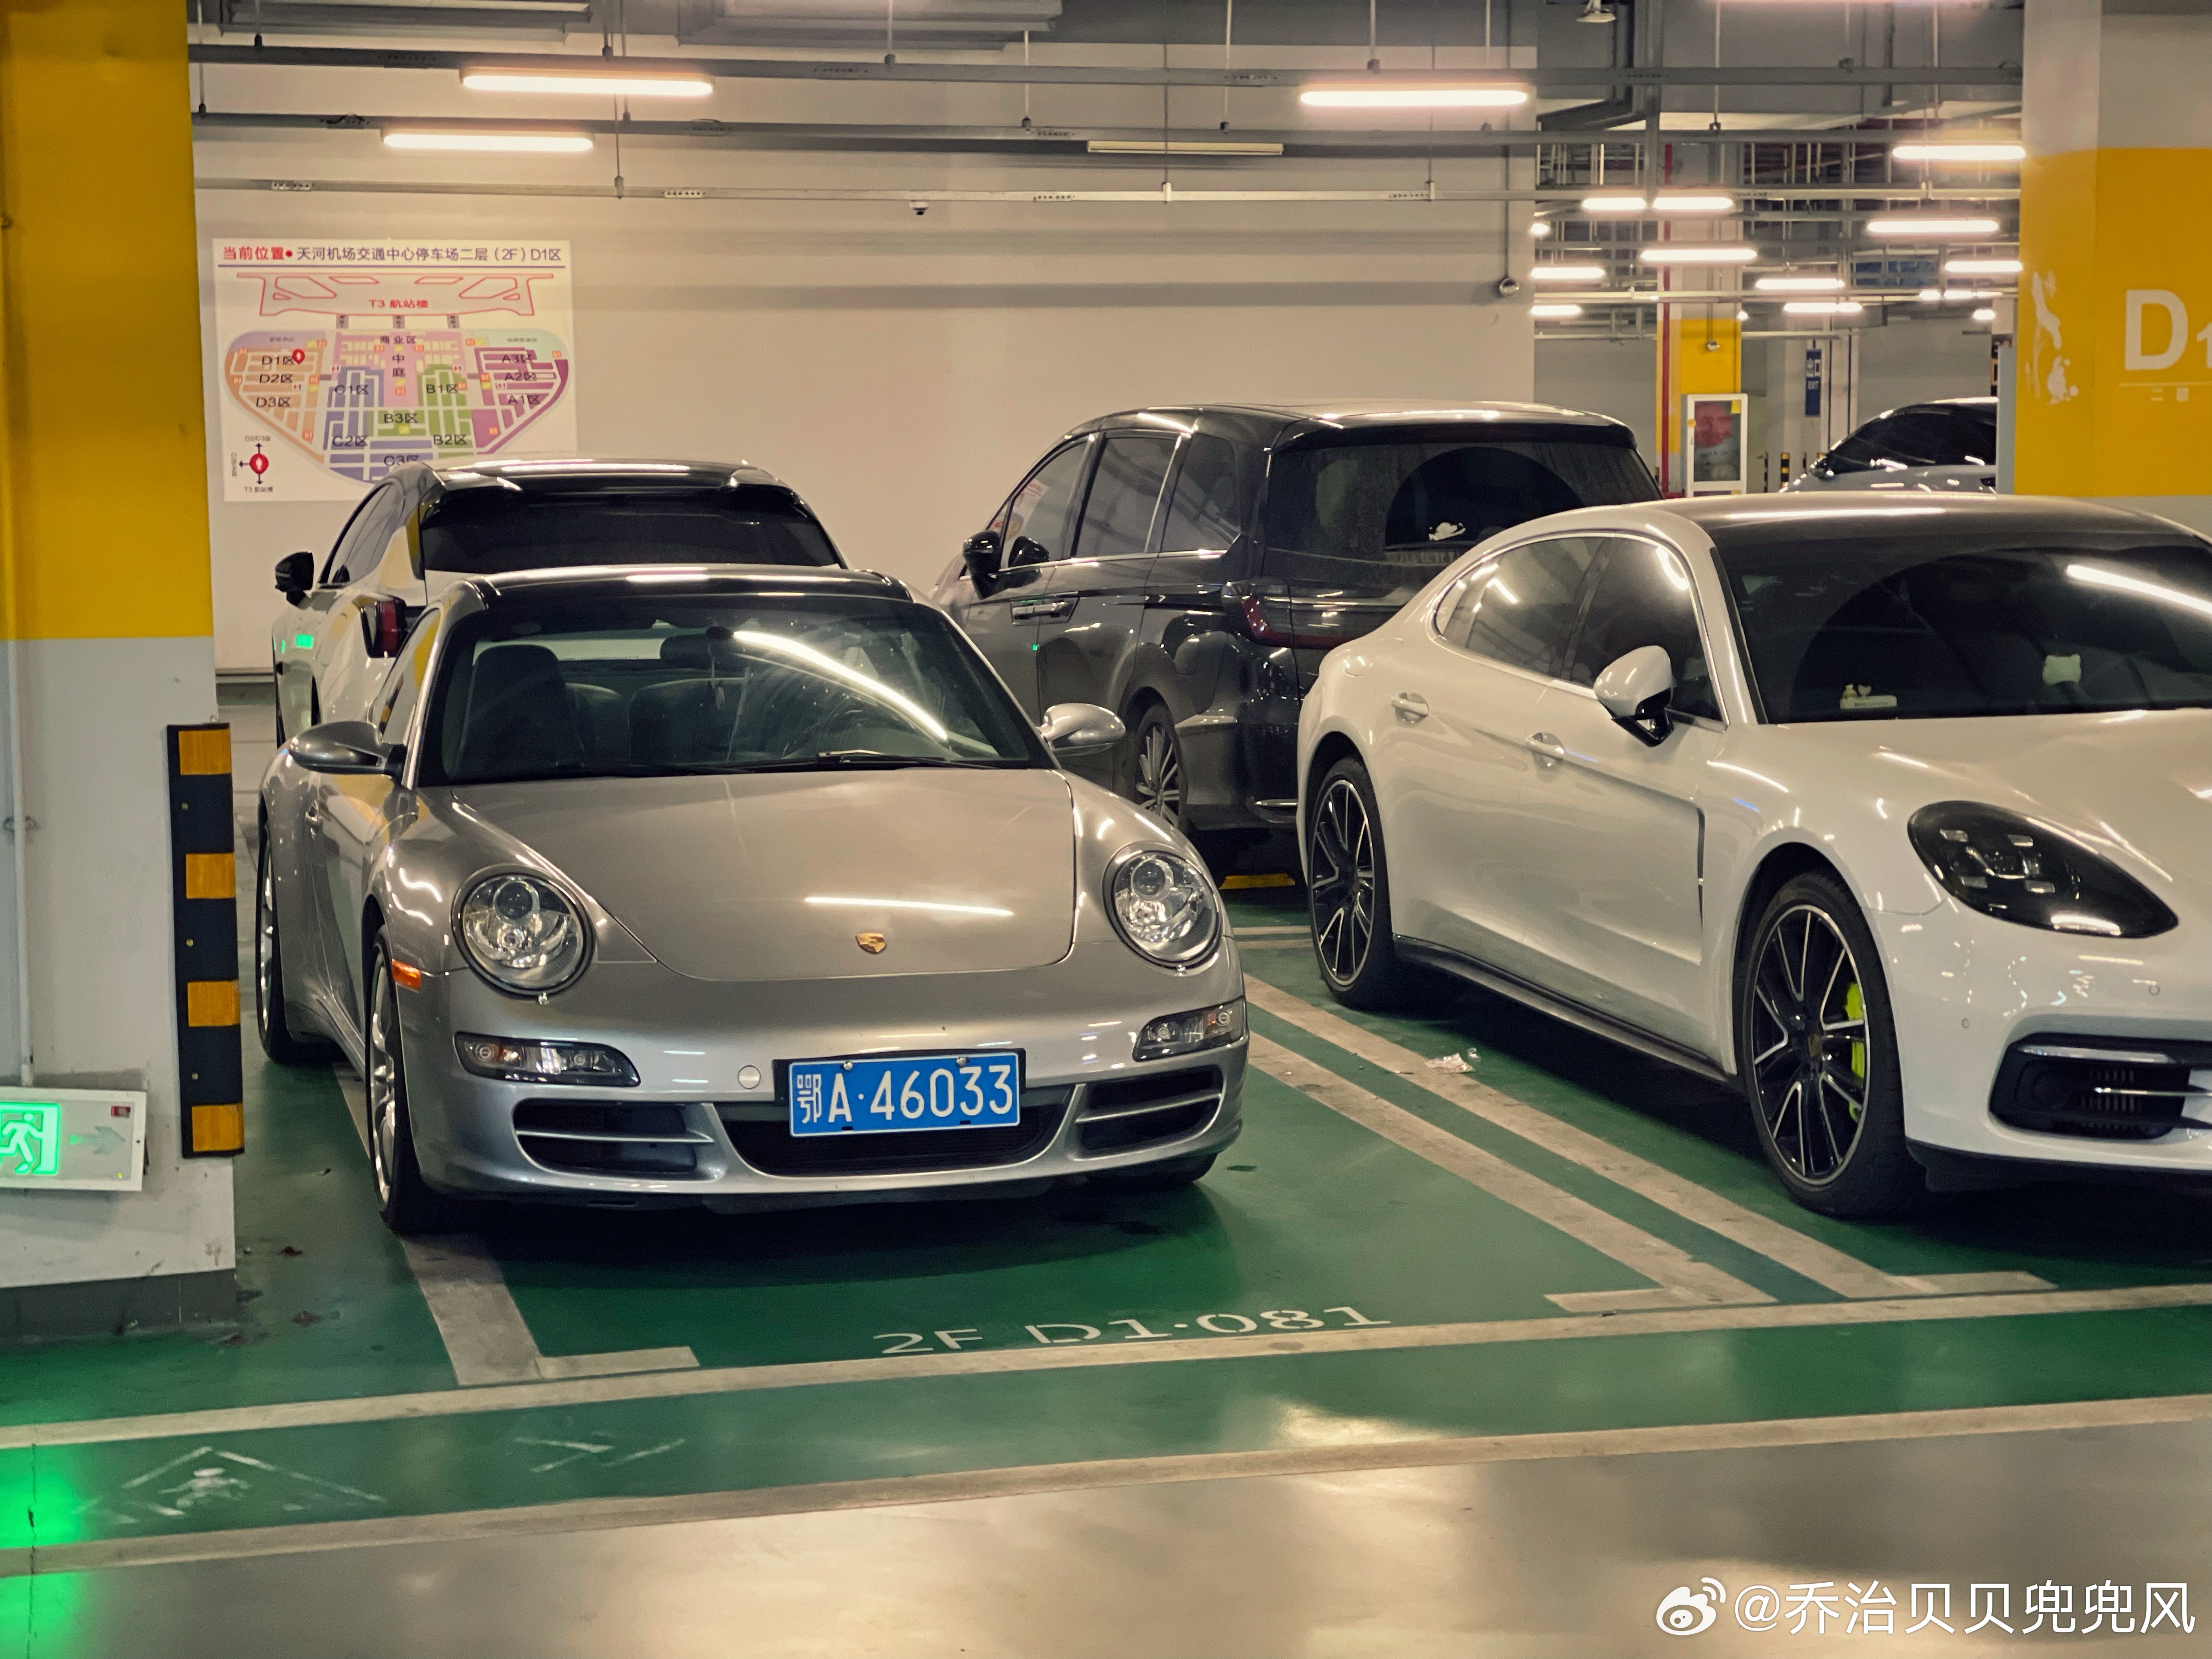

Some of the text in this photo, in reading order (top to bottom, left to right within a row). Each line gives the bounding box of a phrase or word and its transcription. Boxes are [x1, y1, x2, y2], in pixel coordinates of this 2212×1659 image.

[223, 246, 284, 260] 当前位置
[369, 298, 428, 308] T3 航站楼
[380, 335, 416, 345] 商业区
[262, 355, 295, 365] D1区
[501, 354, 532, 363] A3区
[259, 374, 294, 383] D2区
[504, 372, 537, 381] A2区
[335, 384, 369, 395] C1区
[426, 384, 458, 394] B1区
[256, 397, 291, 408] D3区
[507, 394, 541, 405] A1区
[384, 413, 418, 424] B3区
[332, 435, 369, 447] C2区
[433, 434, 468, 445] B2区
[796, 1064, 1013, 1124] 鄂A·46033
[872, 1328, 983, 1354] 2F
